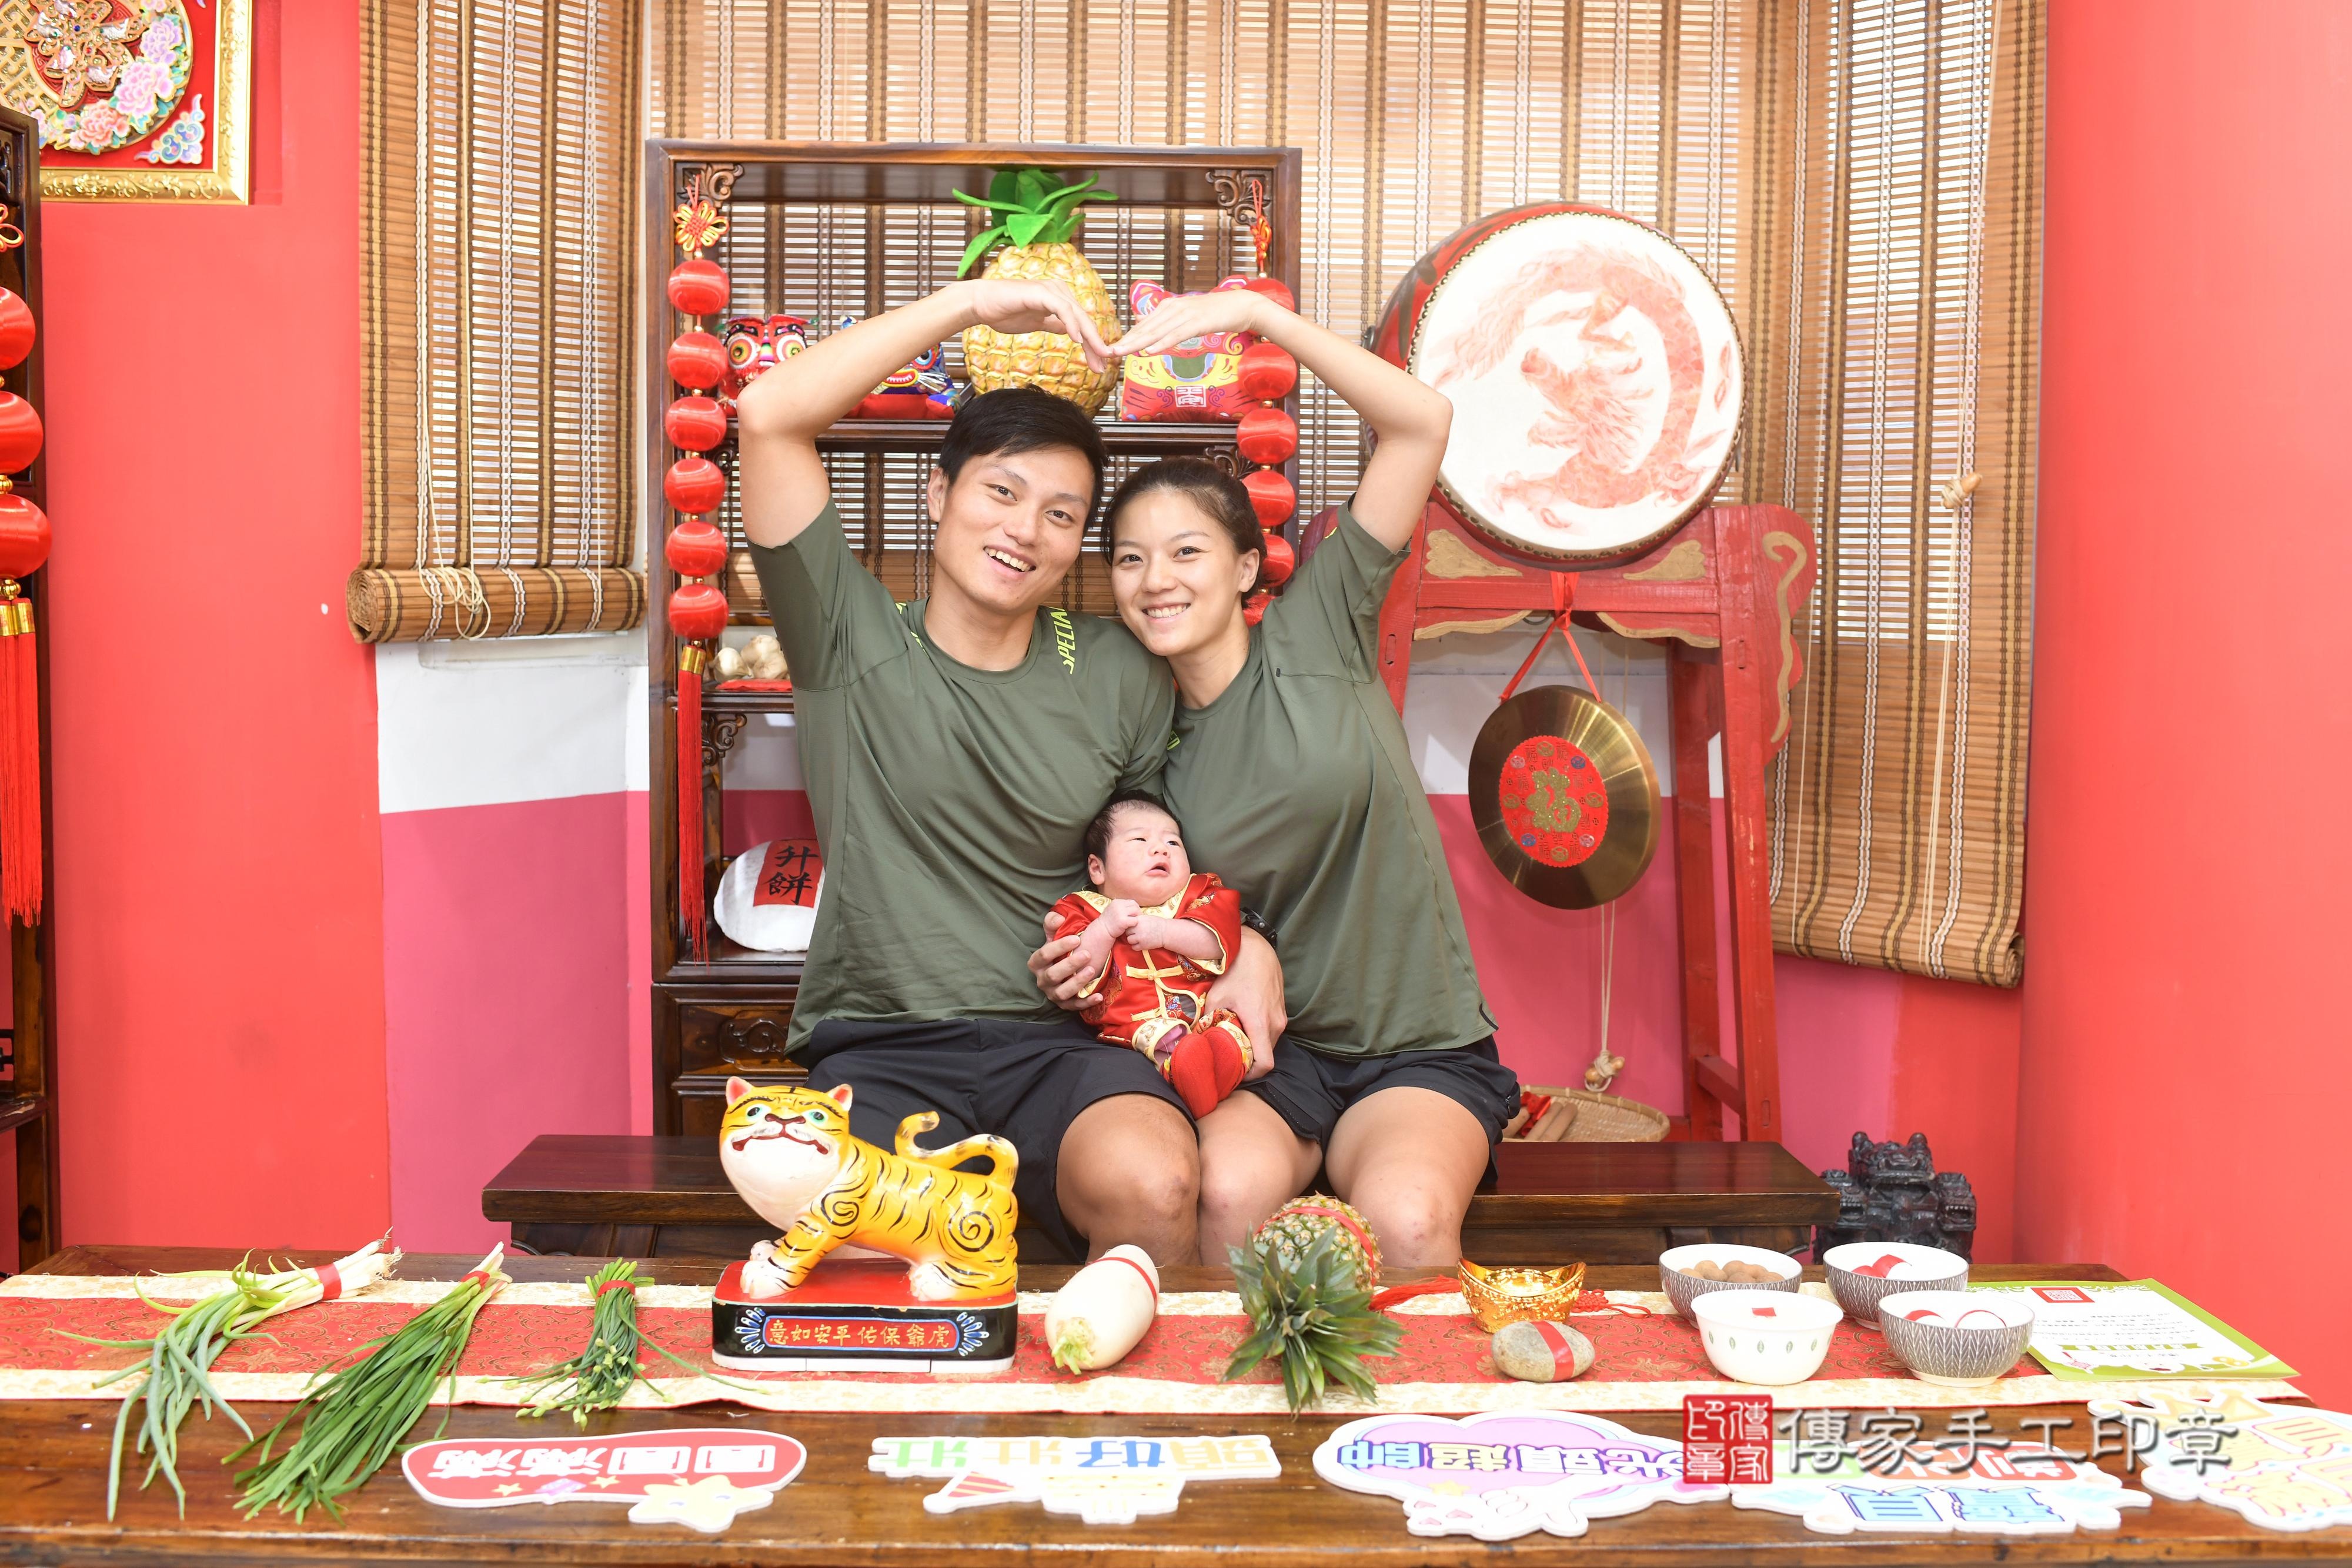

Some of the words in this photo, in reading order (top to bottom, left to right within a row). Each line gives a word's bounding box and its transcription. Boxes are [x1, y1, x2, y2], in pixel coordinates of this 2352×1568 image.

[1048, 606, 1076, 675] SPECIA
[1525, 766, 1582, 834] 福
[763, 845, 820, 905] 升餅
[427, 1445, 777, 1477] 圓圓滿滿
[882, 1439, 1272, 1471] 頭好壯壯
[1338, 1440, 1684, 1478] 光頭超帥
